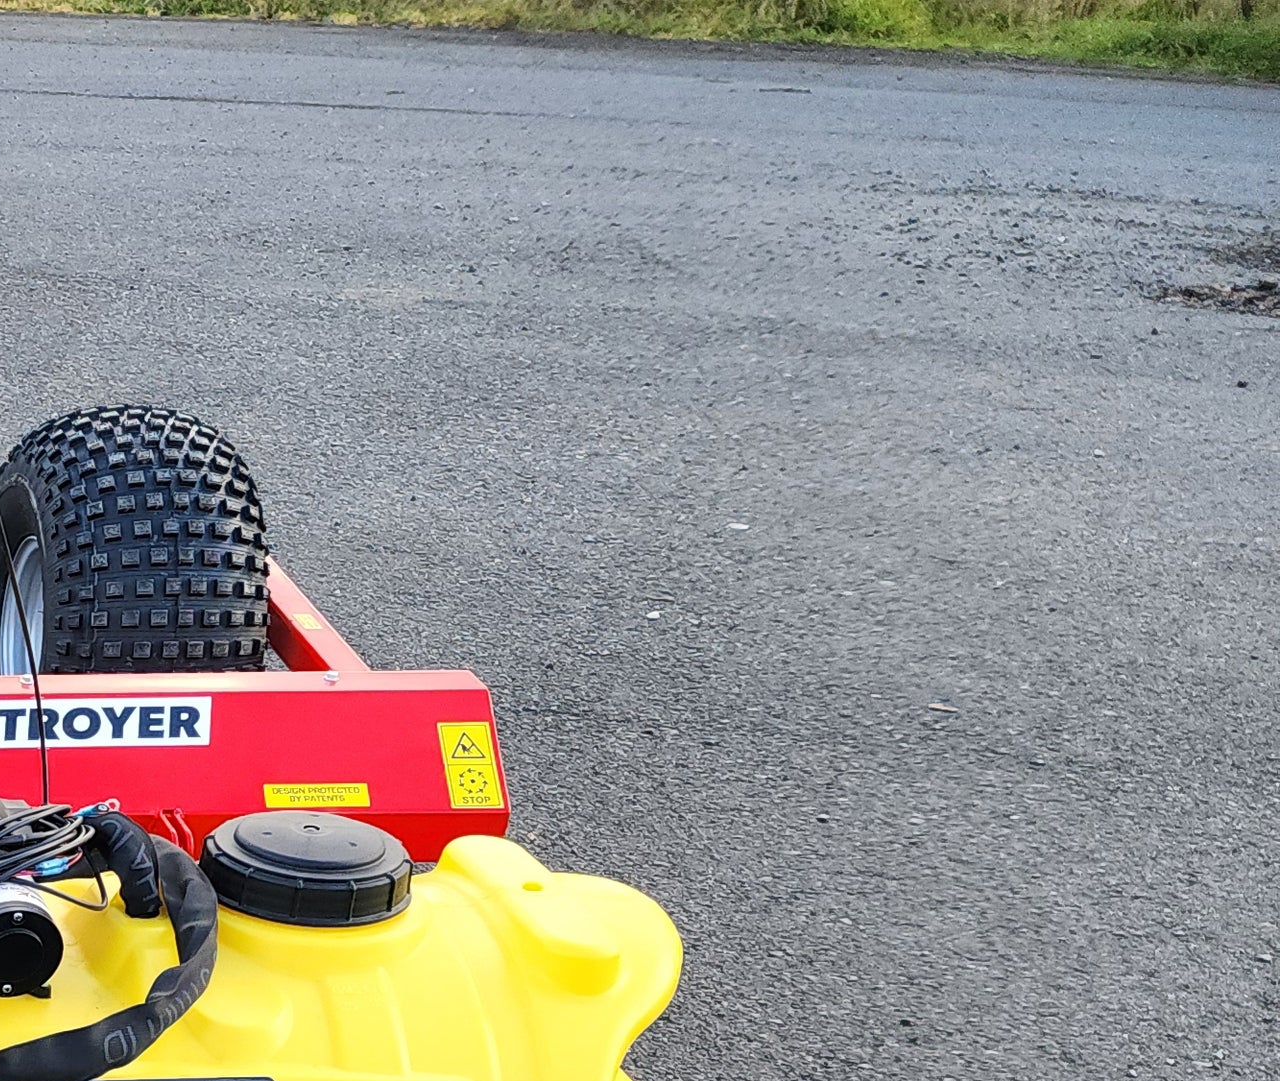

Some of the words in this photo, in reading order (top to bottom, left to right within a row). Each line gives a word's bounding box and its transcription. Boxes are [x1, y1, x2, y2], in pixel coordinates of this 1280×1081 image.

[272, 787, 306, 795] DESIGN
[308, 786, 360, 795] PROTECTED
[289, 795, 303, 803] BY
[304, 794, 346, 802] PATENTS
[462, 796, 490, 805] STOP
